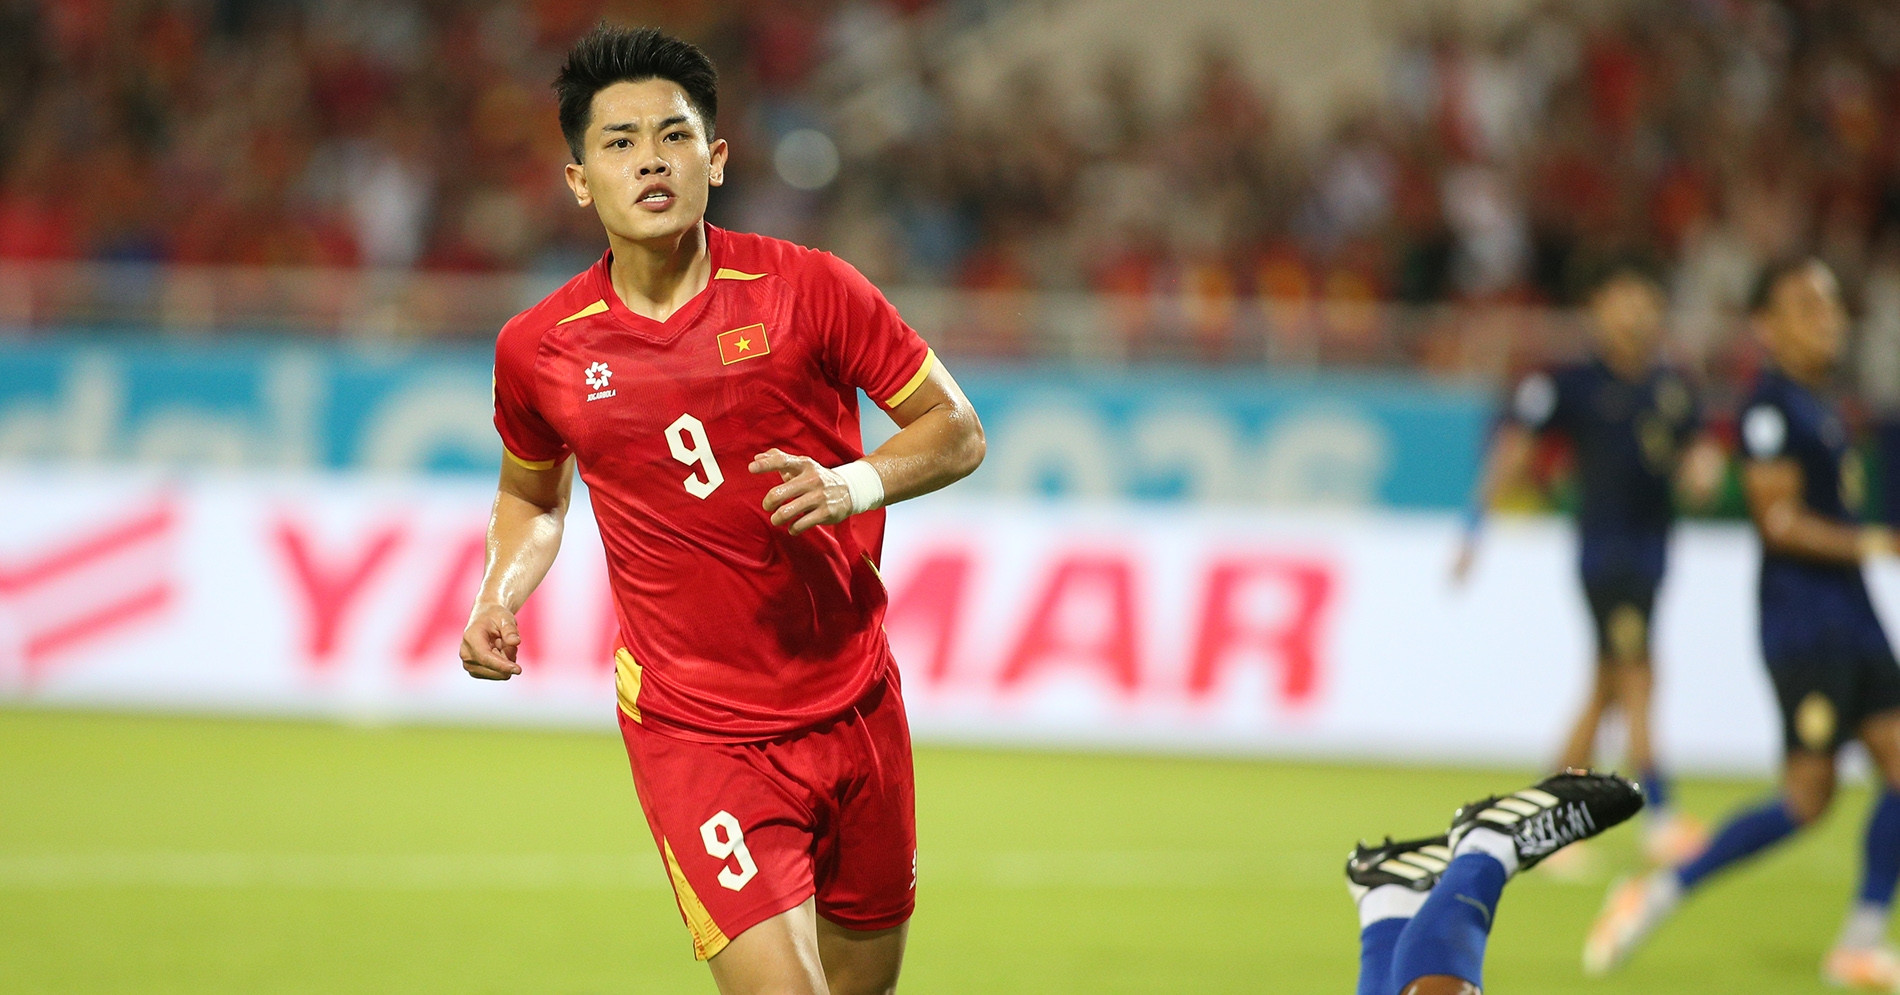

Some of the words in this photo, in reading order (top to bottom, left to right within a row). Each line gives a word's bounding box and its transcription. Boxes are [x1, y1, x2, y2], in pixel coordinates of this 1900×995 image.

[664, 412, 725, 500] 9
[270, 520, 1338, 704] YAMAR
[700, 809, 758, 892] 9
